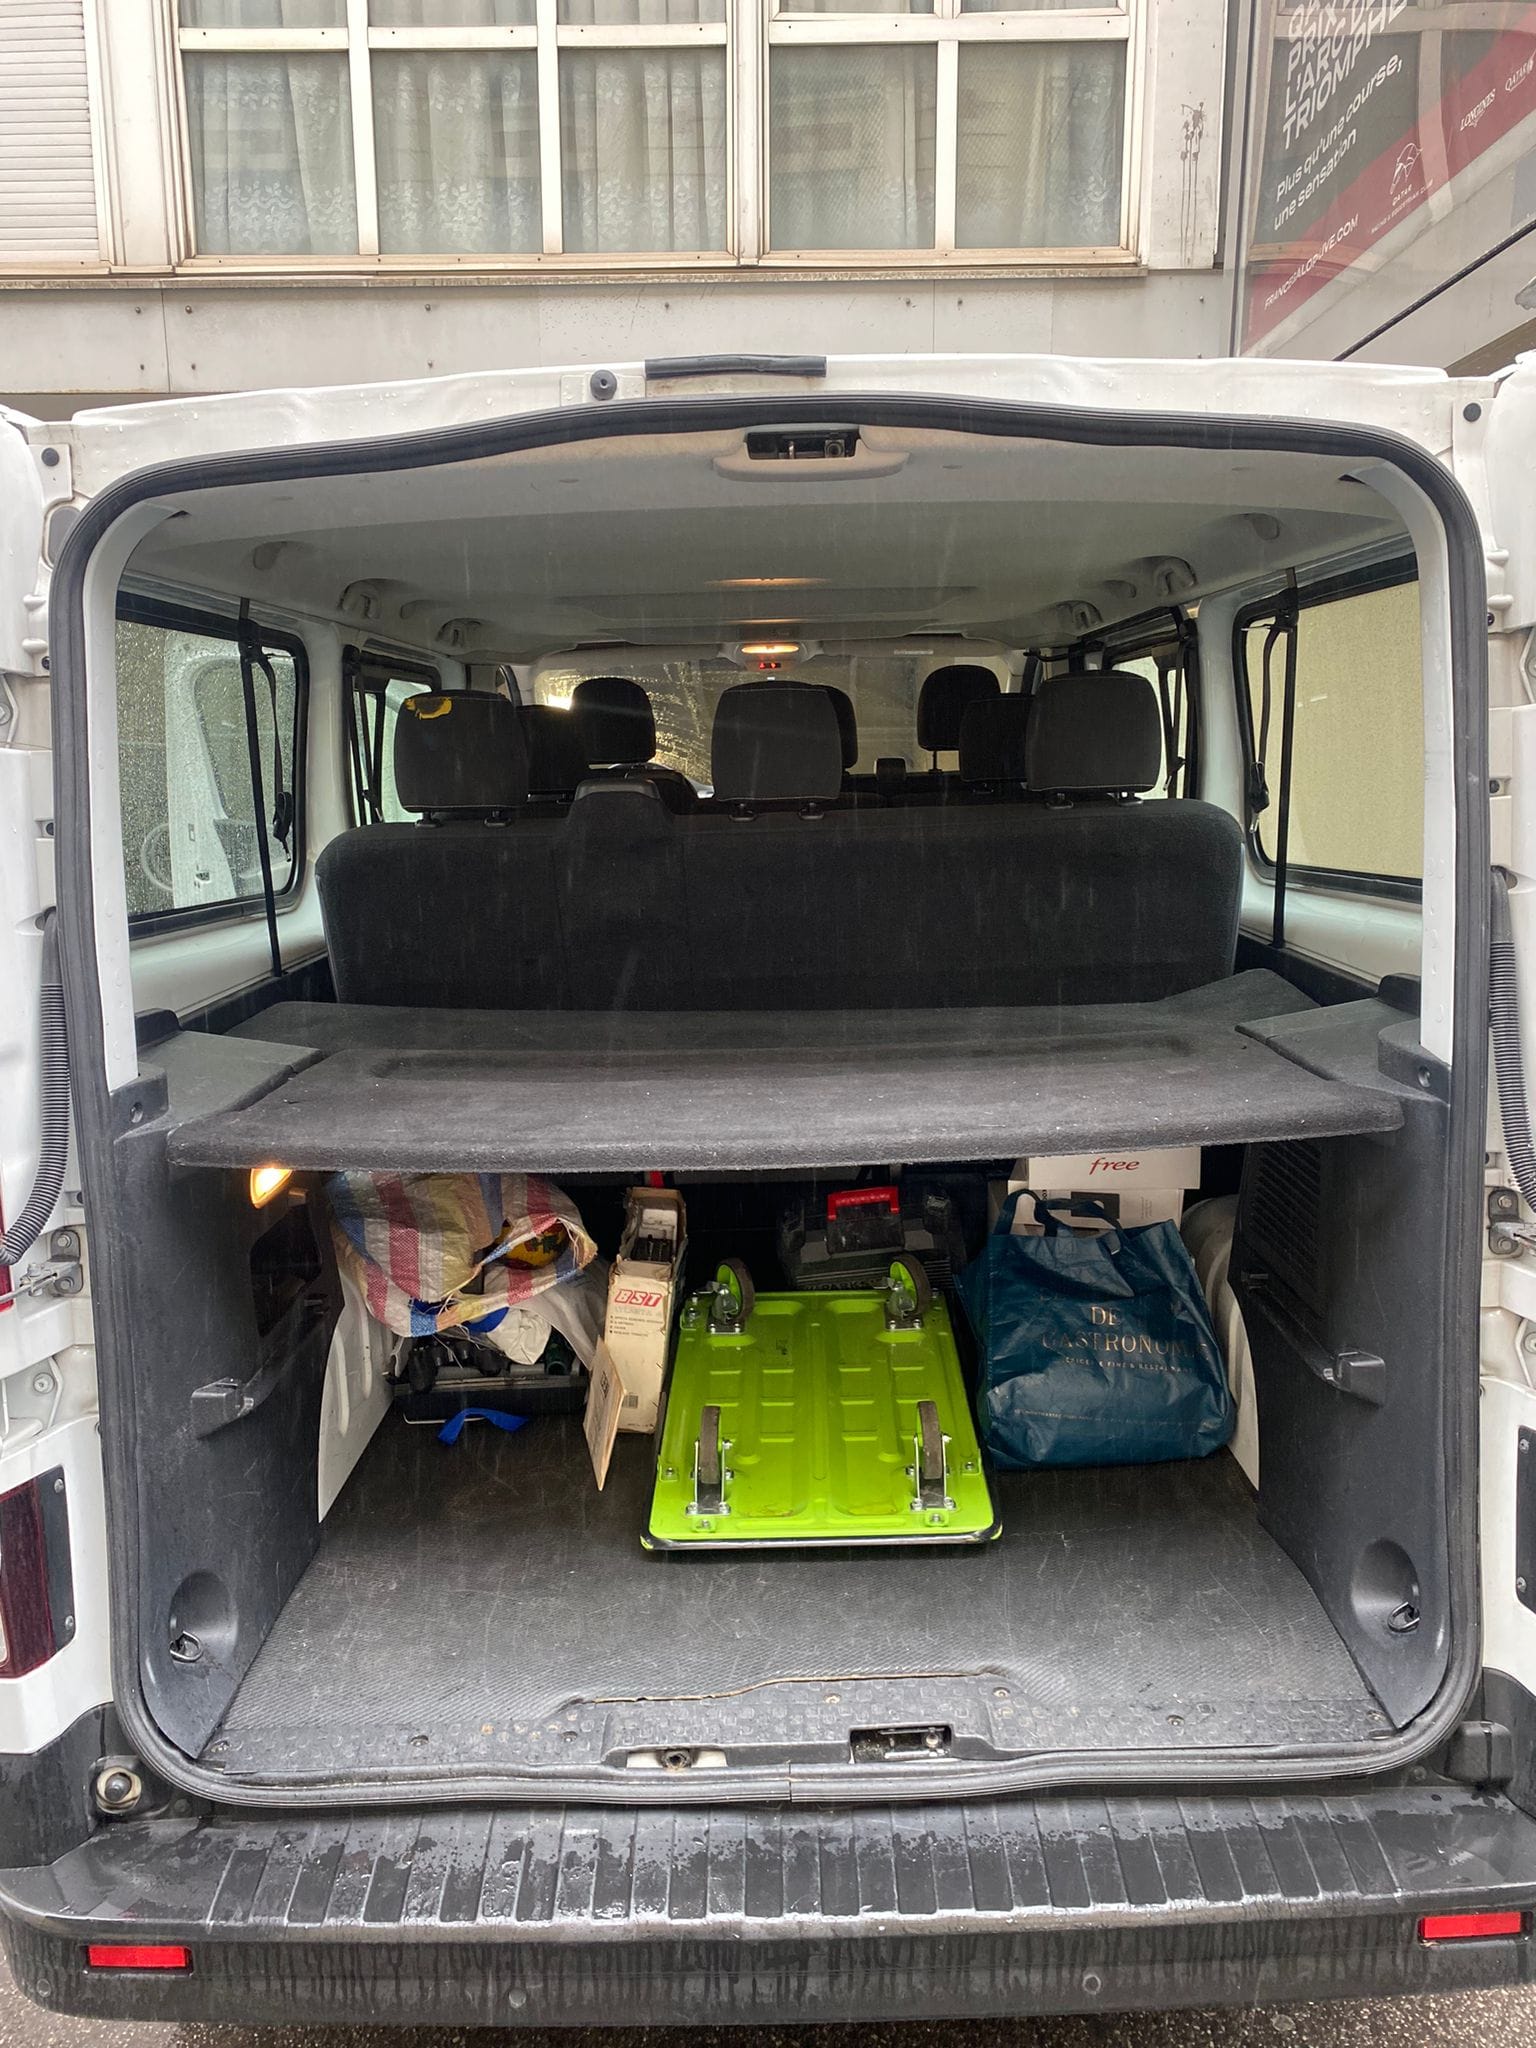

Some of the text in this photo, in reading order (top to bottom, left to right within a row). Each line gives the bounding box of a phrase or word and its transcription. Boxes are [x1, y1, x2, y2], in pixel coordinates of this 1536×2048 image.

[1285, 17, 1346, 119] L'ARC
[1276, 54, 1403, 204] Plus qu'une course,
[1273, 128, 1357, 231] une sensation
[1088, 1157, 1141, 1175] free
[614, 1289, 663, 1307] BST
[1090, 1305, 1121, 1326] DE
